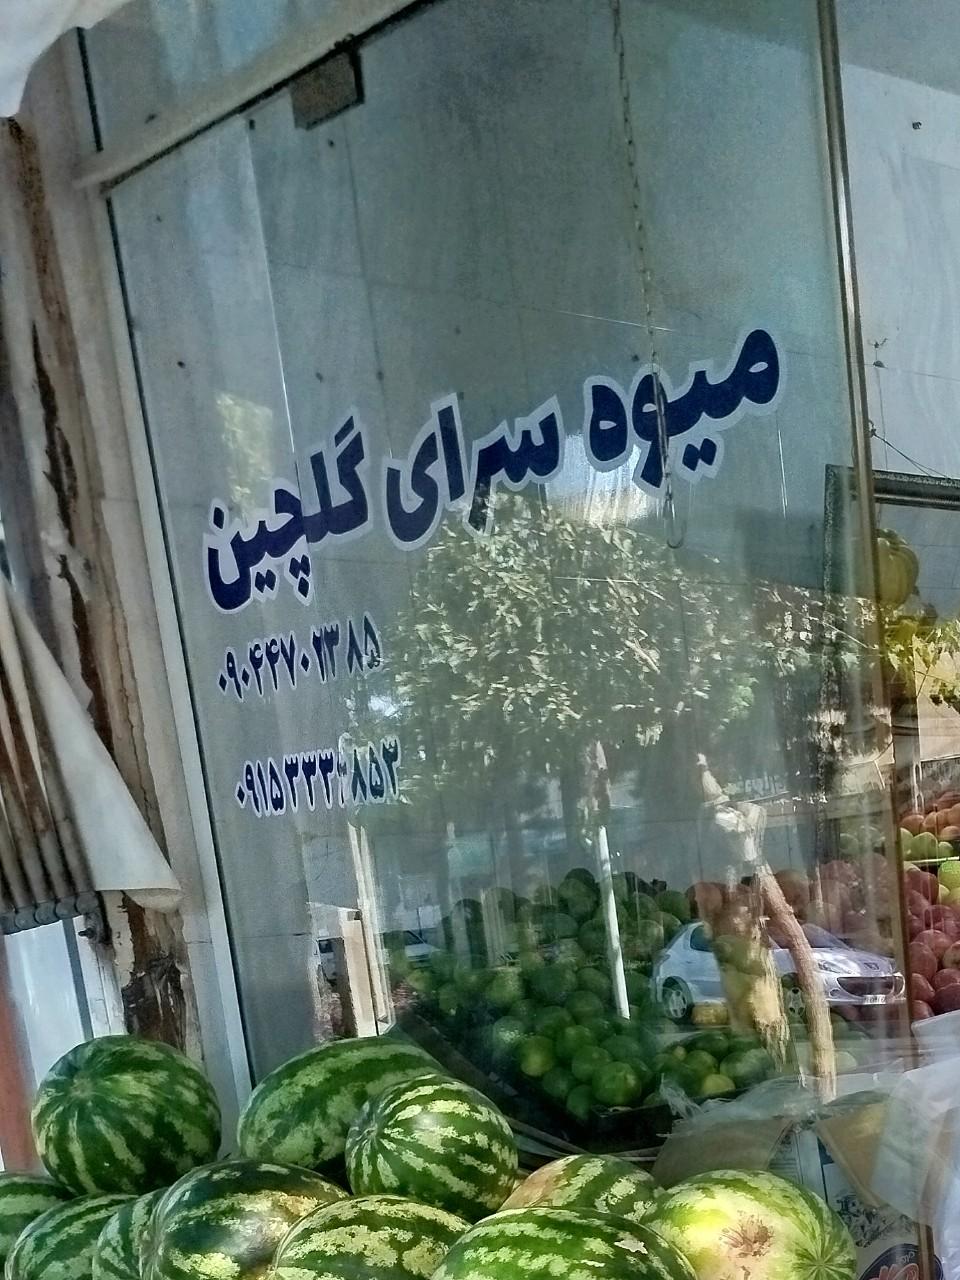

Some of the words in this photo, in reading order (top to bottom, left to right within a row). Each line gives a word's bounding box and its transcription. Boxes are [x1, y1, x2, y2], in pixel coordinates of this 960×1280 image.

[386, 404, 560, 544] سرای
[588, 327, 780, 488] میوه
[206, 413, 370, 612] گلچین
